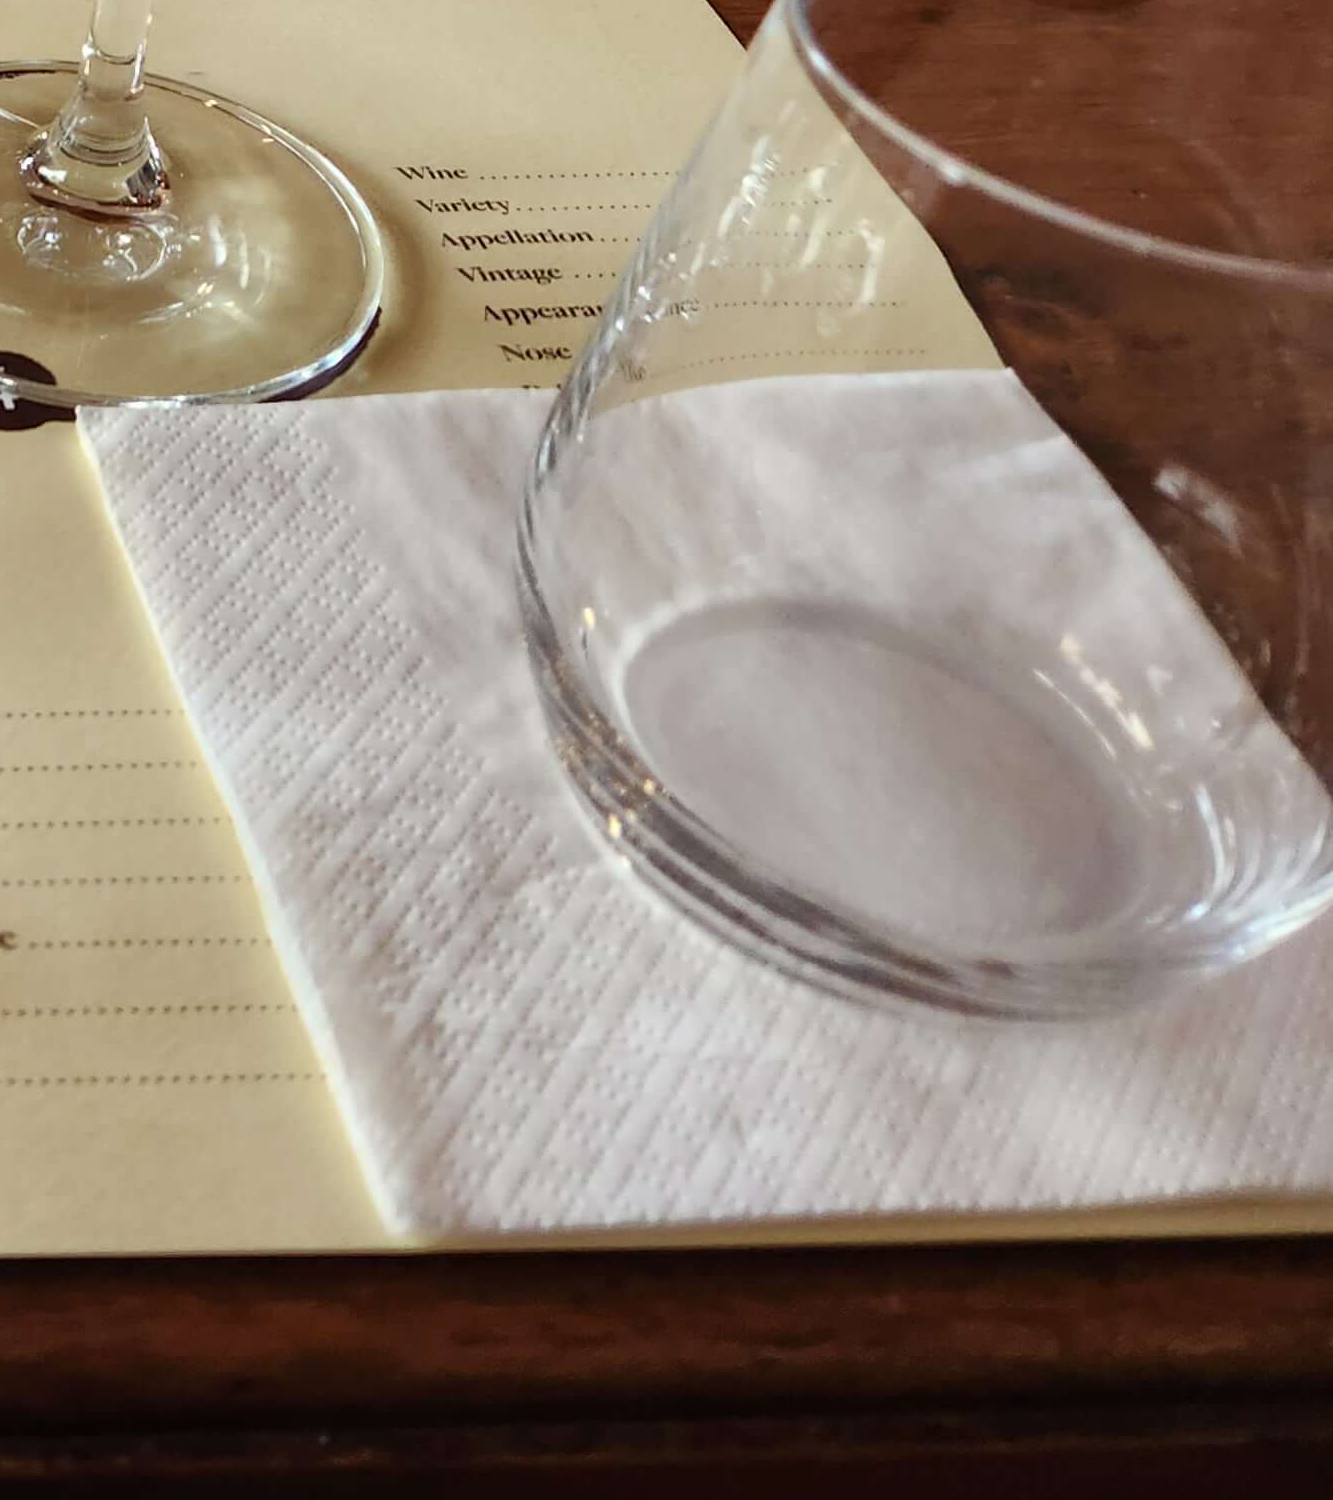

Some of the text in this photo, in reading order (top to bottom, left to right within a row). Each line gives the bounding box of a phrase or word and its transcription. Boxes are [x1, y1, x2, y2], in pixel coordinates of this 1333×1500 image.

[396, 166, 469, 181] Wine
[414, 198, 510, 215] Variety
[441, 229, 594, 251] Appellation
[457, 266, 563, 285] Vintage
[484, 304, 604, 326] Appeara
[497, 343, 573, 363] Nose
